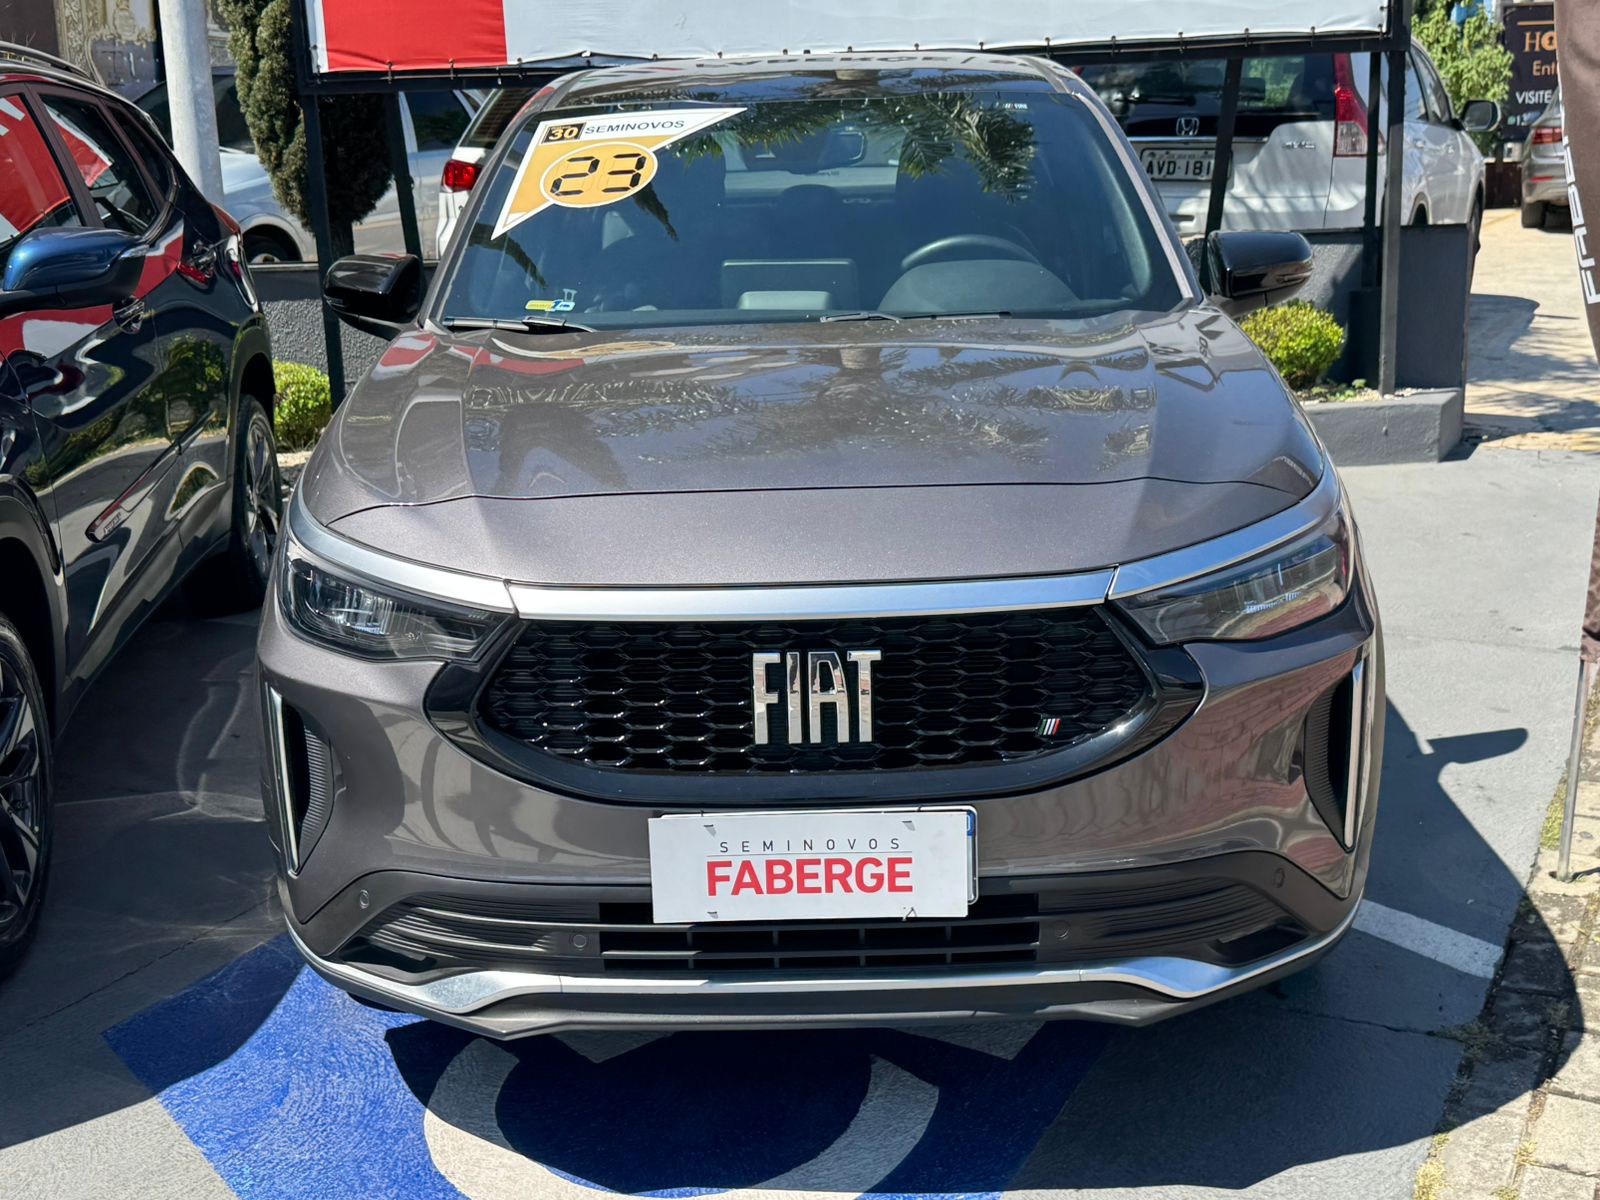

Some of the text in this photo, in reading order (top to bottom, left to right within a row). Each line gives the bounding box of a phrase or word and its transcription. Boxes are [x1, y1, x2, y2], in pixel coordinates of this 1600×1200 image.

[1523, 31, 1557, 52] HO
[1515, 89, 1552, 104] VISITE
[548, 126, 579, 141] 30
[584, 120, 685, 135] SEMINOVOS
[550, 153, 646, 197] 23
[1146, 160, 1211, 176] AVD-181
[752, 650, 882, 745] FIAT
[719, 838, 901, 853] SEMINOVOS
[706, 857, 914, 897] FABERGE
